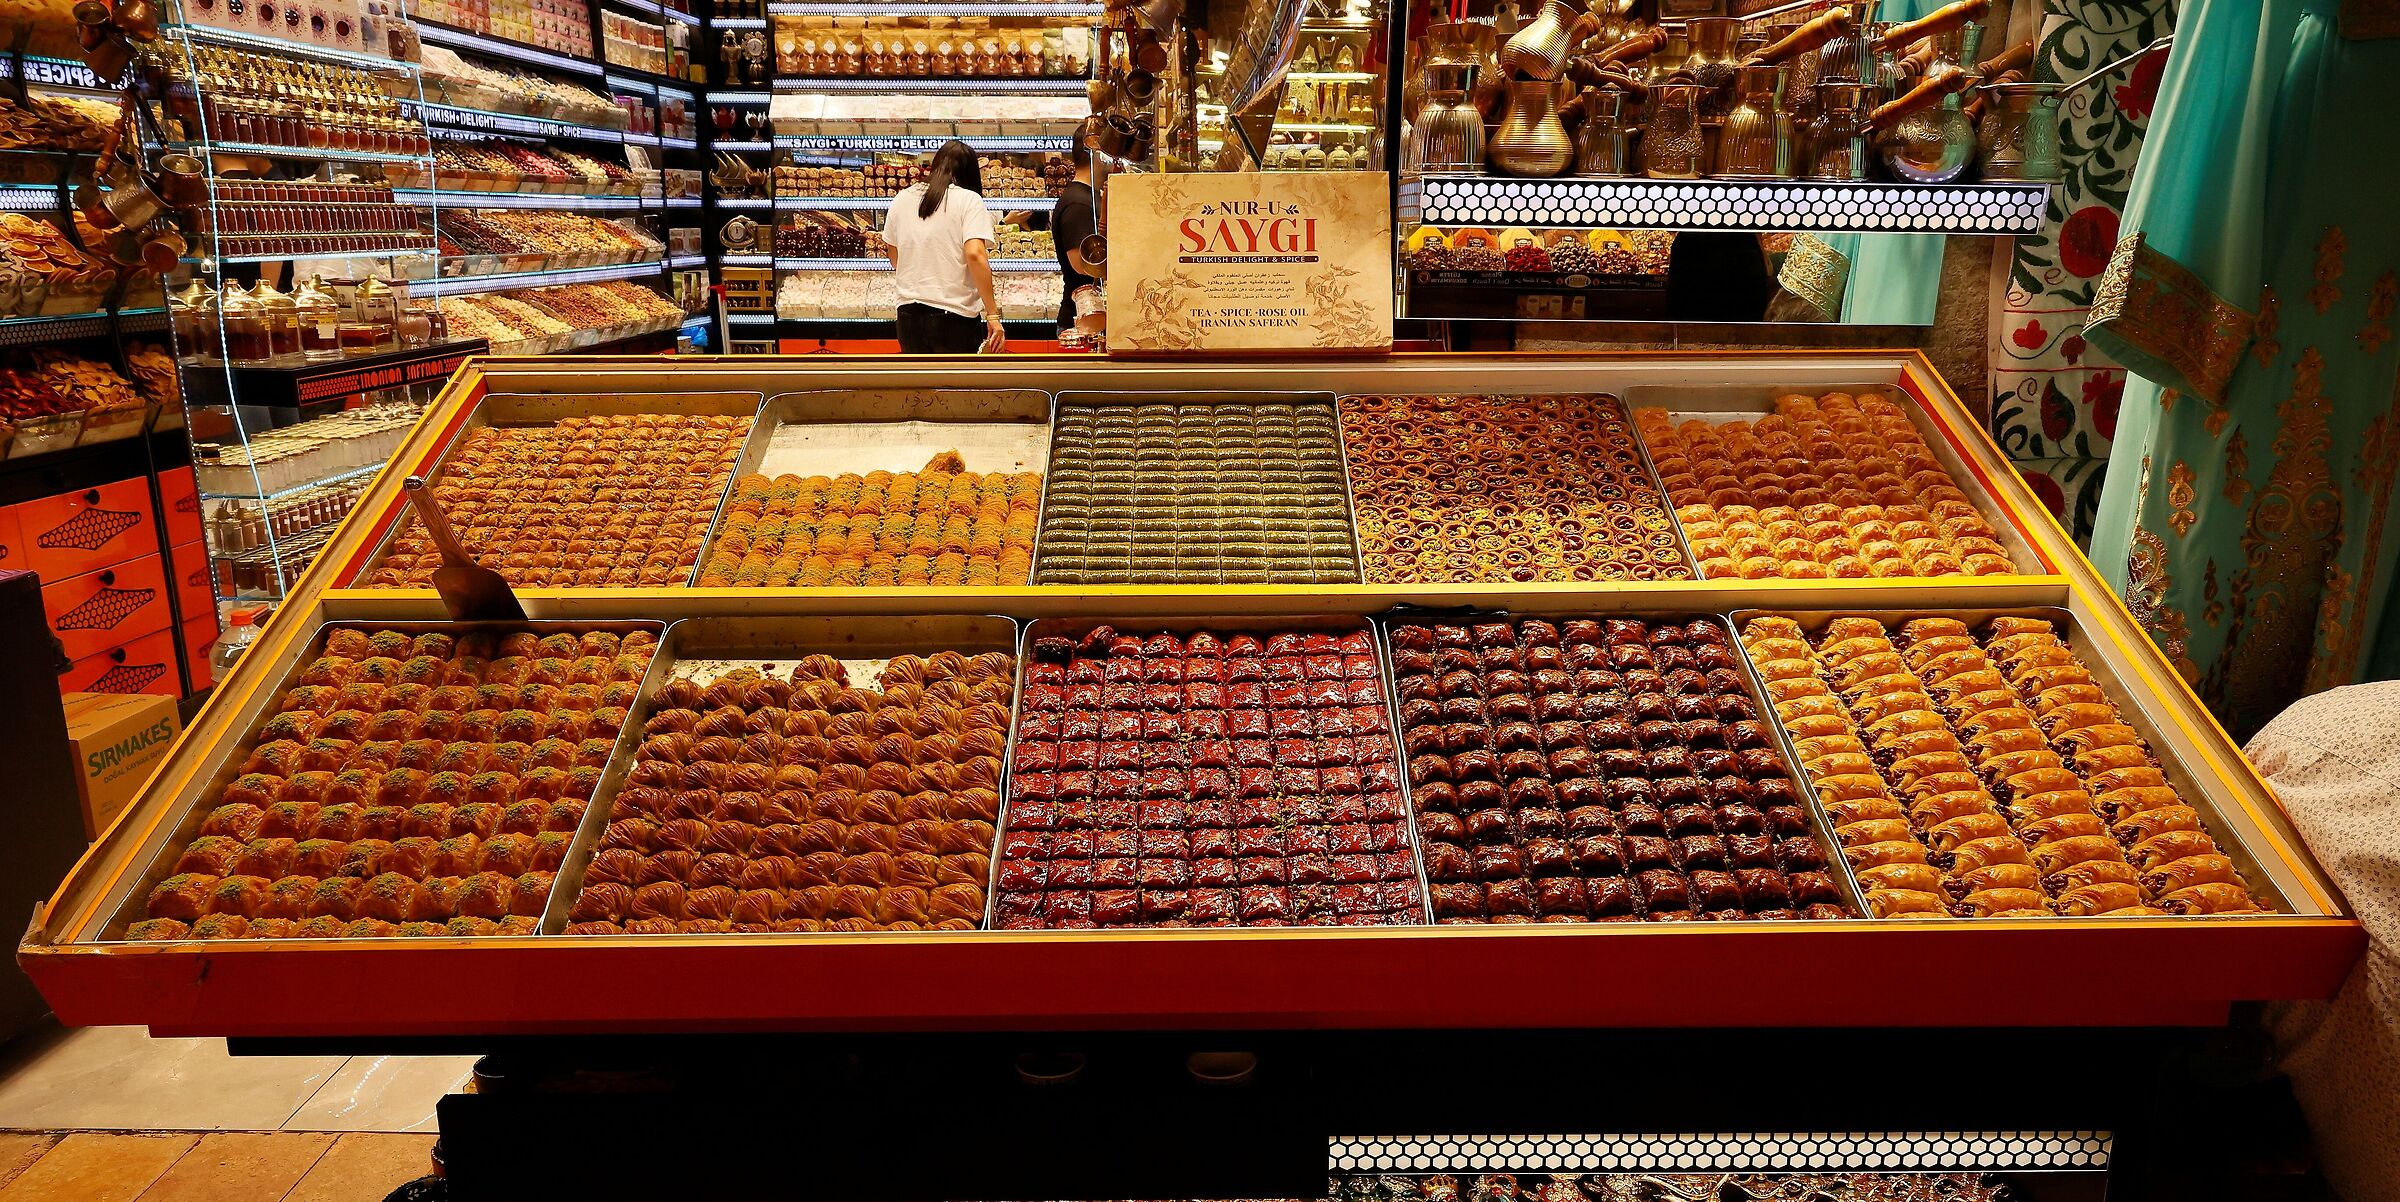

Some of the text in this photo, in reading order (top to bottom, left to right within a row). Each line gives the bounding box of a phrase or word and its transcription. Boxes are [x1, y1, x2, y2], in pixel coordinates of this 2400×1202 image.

[416, 105, 456, 124] TURKISH
[460, 112, 496, 129] DELIGHT
[539, 123, 581, 138] SAYGI SPICE
[794, 139, 949, 149] SAYGI TURKISH DELIGH
[1036, 139, 1073, 149] SAYGI
[1220, 201, 1281, 216] NUR-U
[1179, 218, 1318, 254] SAYGI
[1190, 308, 1309, 317] TEA SPICE ROSE OIL
[1200, 318, 1299, 328] IRANIAN SAFERAN
